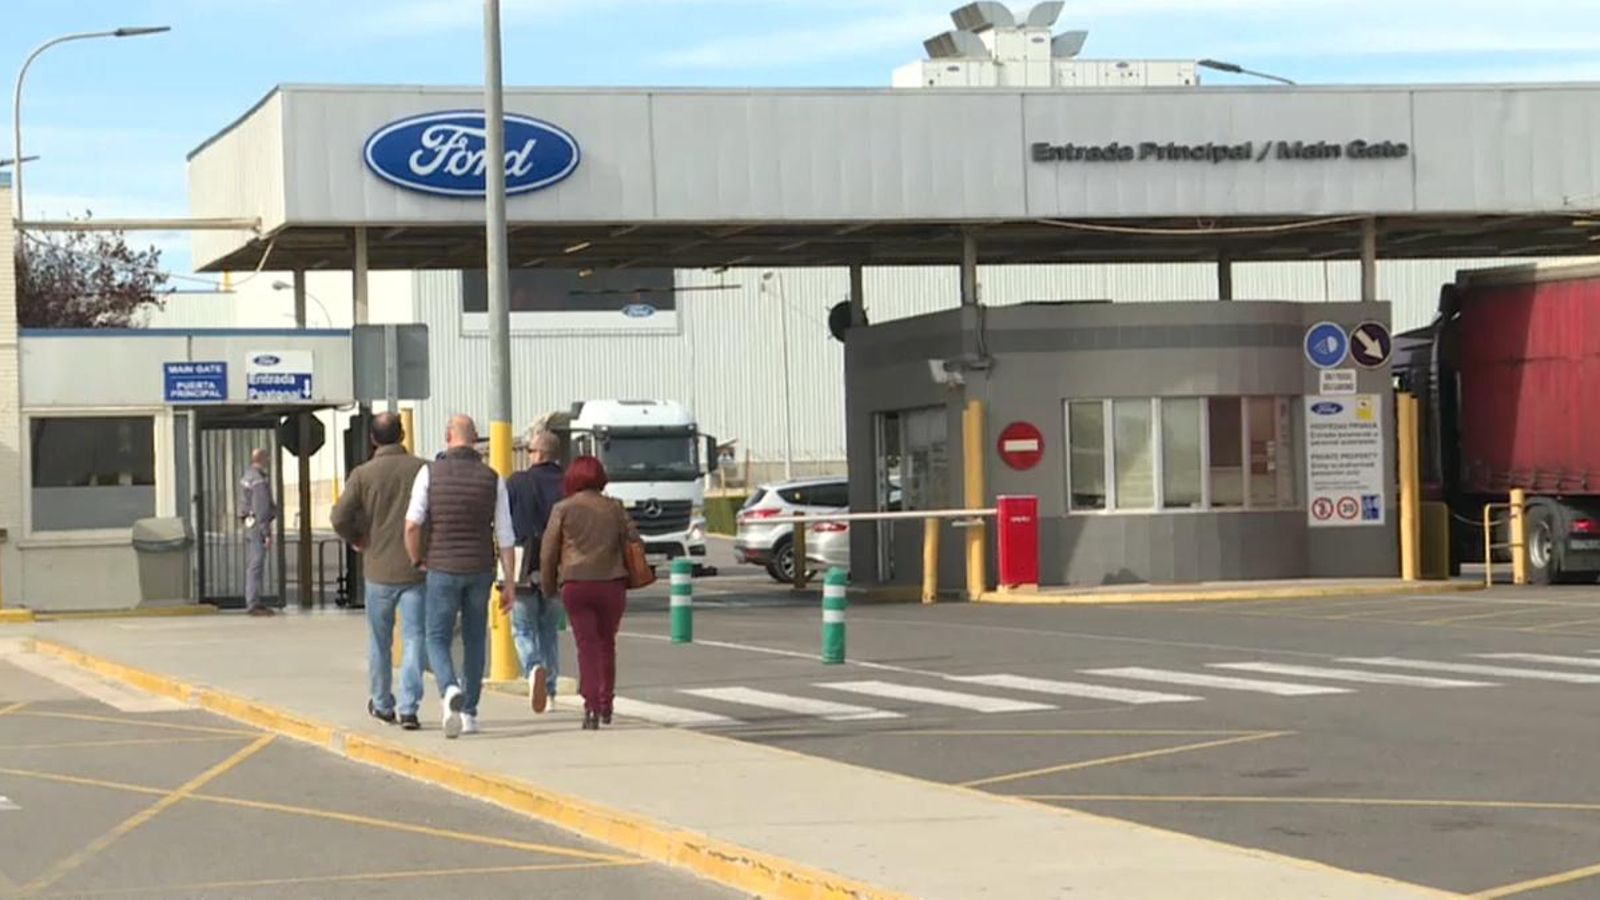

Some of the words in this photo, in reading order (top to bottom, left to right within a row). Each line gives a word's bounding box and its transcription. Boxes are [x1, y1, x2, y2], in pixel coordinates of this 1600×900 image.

[1031, 142, 1134, 162] Entrada
[1138, 141, 1253, 164] Principal
[1276, 141, 1341, 160] Main
[1346, 139, 1409, 160] Gate
[168, 365, 194, 374] MAIN
[196, 365, 223, 374] GATE
[249, 374, 296, 385] Entrada
[176, 381, 216, 389] PUERTA
[170, 389, 222, 398] PRINCIPAL
